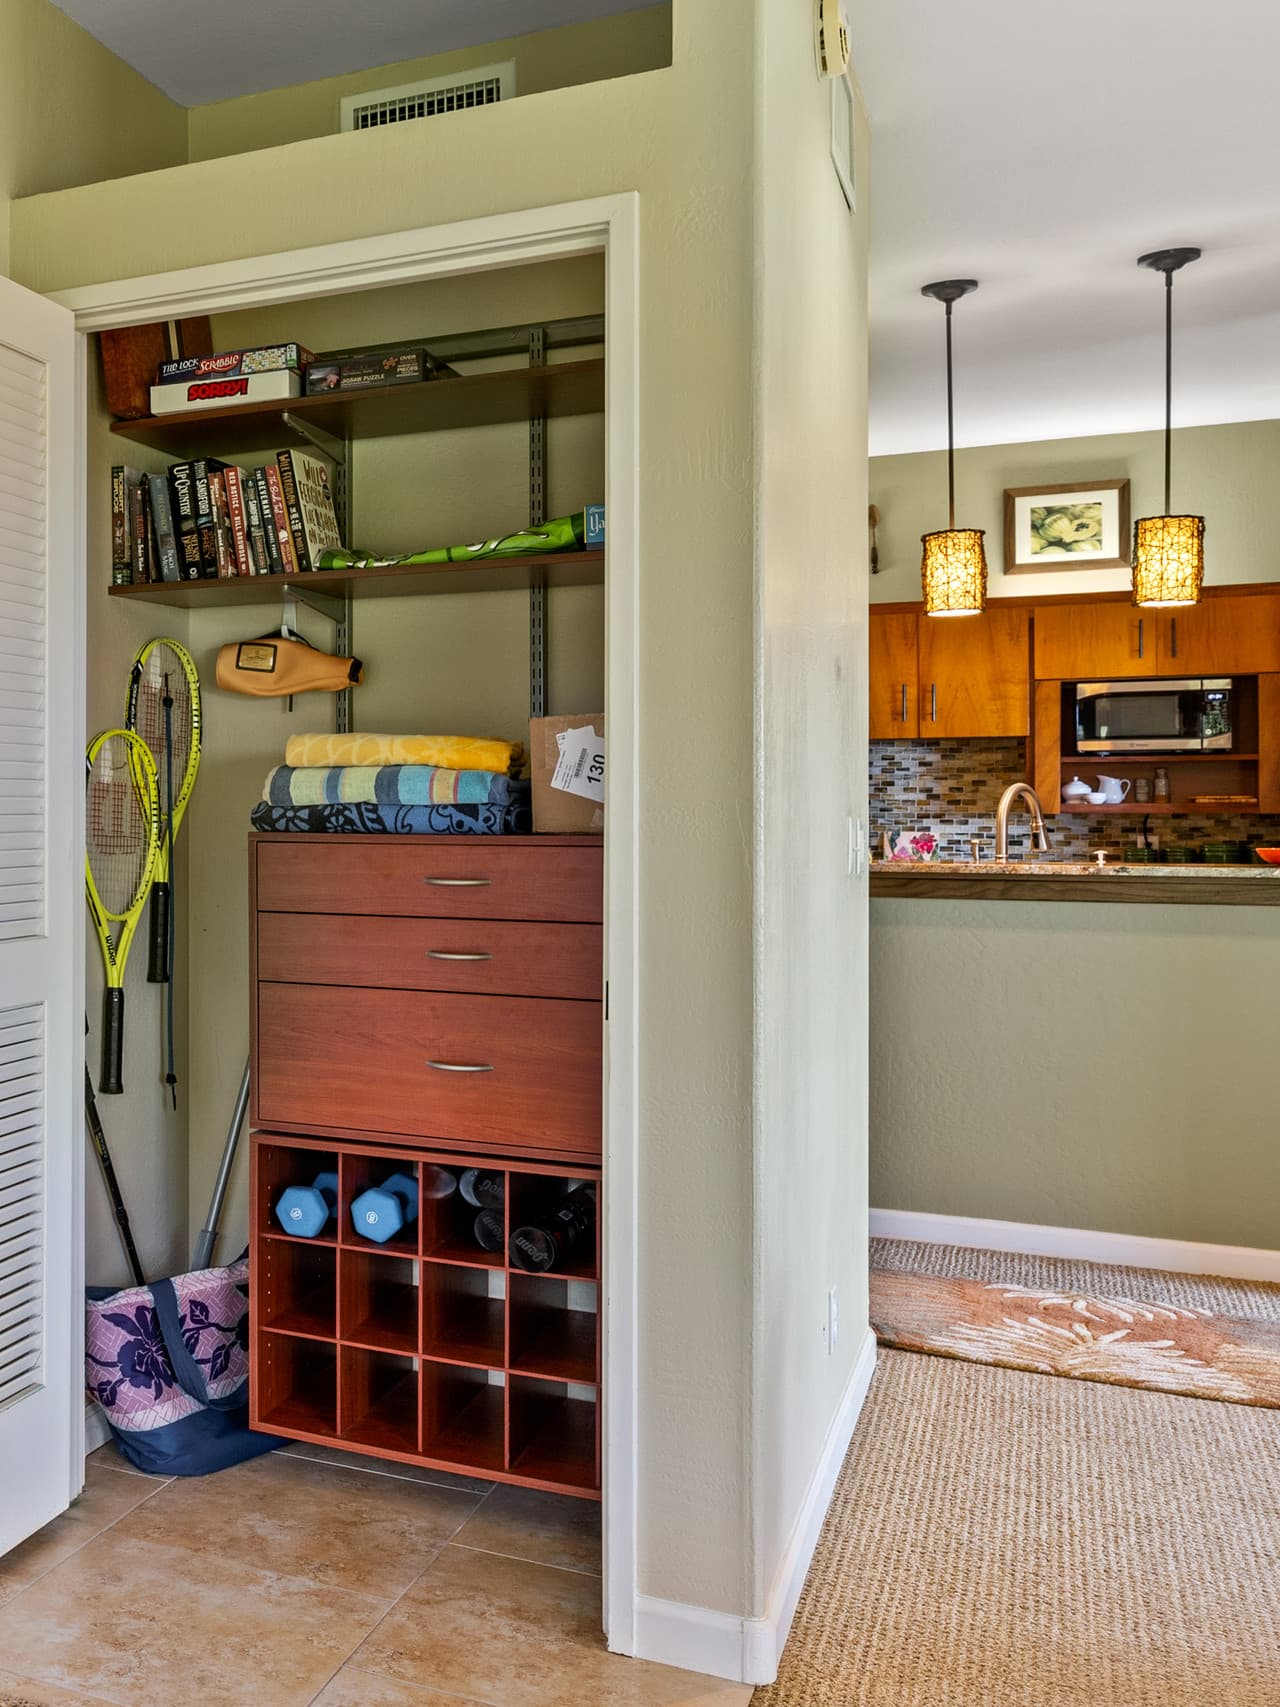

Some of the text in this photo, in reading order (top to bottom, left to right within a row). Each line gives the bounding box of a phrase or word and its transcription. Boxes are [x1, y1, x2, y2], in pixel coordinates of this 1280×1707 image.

[179, 358, 199, 370] LOCK
[200, 354, 239, 373] SCRABBLE
[363, 373, 385, 381] PUZZLE
[187, 378, 248, 401] SORRY!
[278, 454, 297, 505] WILL FERGUSON
[303, 460, 321, 487] WILL
[173, 465, 192, 516] UP COUNTRY
[194, 461, 210, 515] JOHN SANDFORD
[257, 480, 272, 519] REVENANT
[228, 471, 246, 564] RED NOTICE BILL BROWDER
[588, 513, 605, 536] Ya
[587, 754, 605, 784] 130
[105, 935, 117, 966] Wilson
[516, 1237, 547, 1262] Penn
